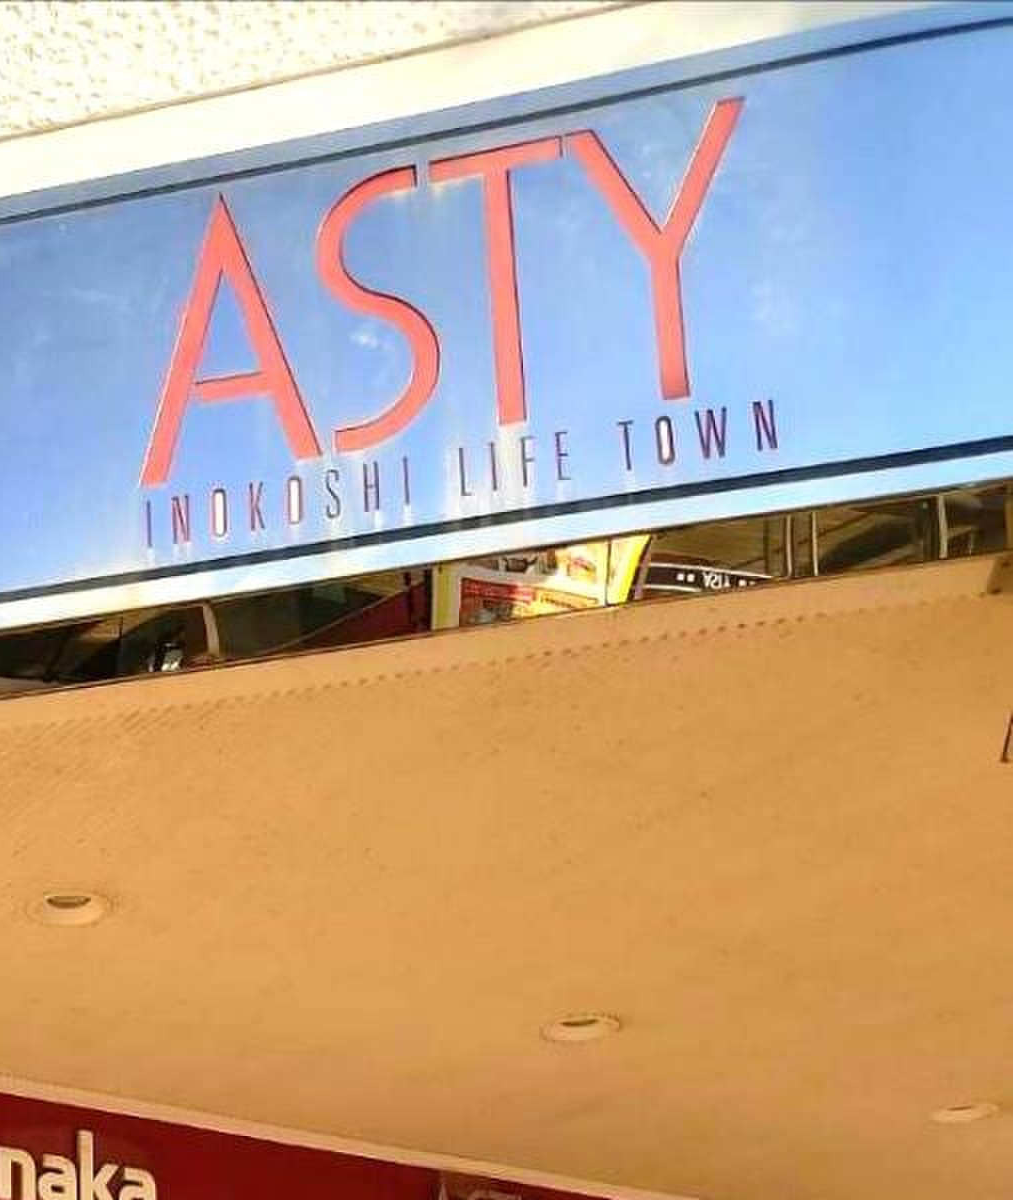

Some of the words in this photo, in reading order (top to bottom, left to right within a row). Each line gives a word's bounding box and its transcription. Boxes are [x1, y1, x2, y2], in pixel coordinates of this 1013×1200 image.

[140, 96, 745, 488] ASTY
[145, 455, 411, 550] INOKOSHI
[458, 430, 571, 497] LIFE
[618, 399, 780, 472] TOWN
